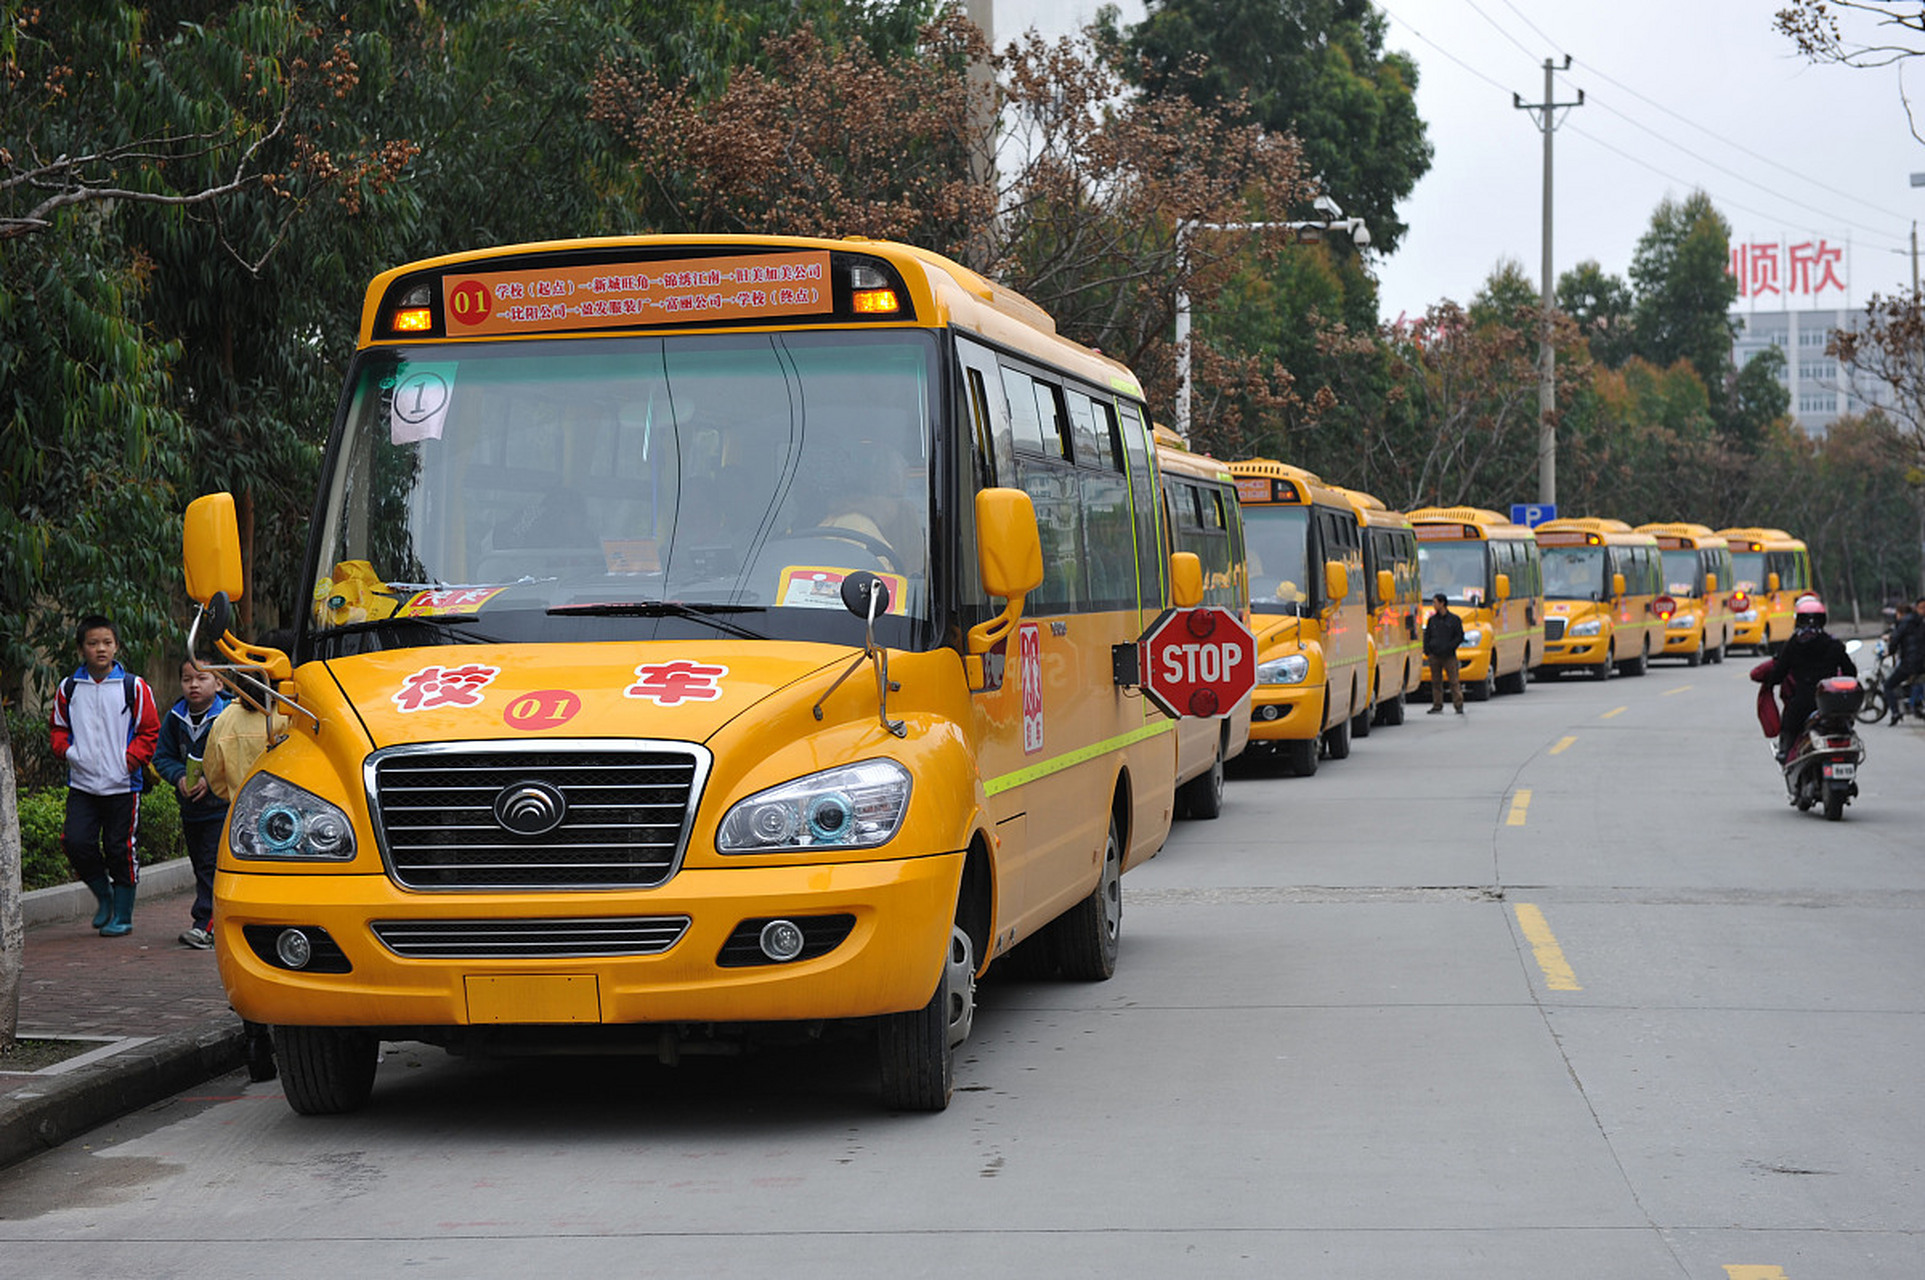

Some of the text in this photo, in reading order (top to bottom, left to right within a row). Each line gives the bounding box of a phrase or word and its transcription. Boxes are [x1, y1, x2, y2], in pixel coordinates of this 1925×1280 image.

[1725, 239, 1846, 298] 顺欣
[454, 289, 489, 314] 01
[1526, 507, 1542, 528] P
[1162, 642, 1242, 683] STOP
[392, 659, 730, 712] 校 车
[511, 697, 573, 723] 01
